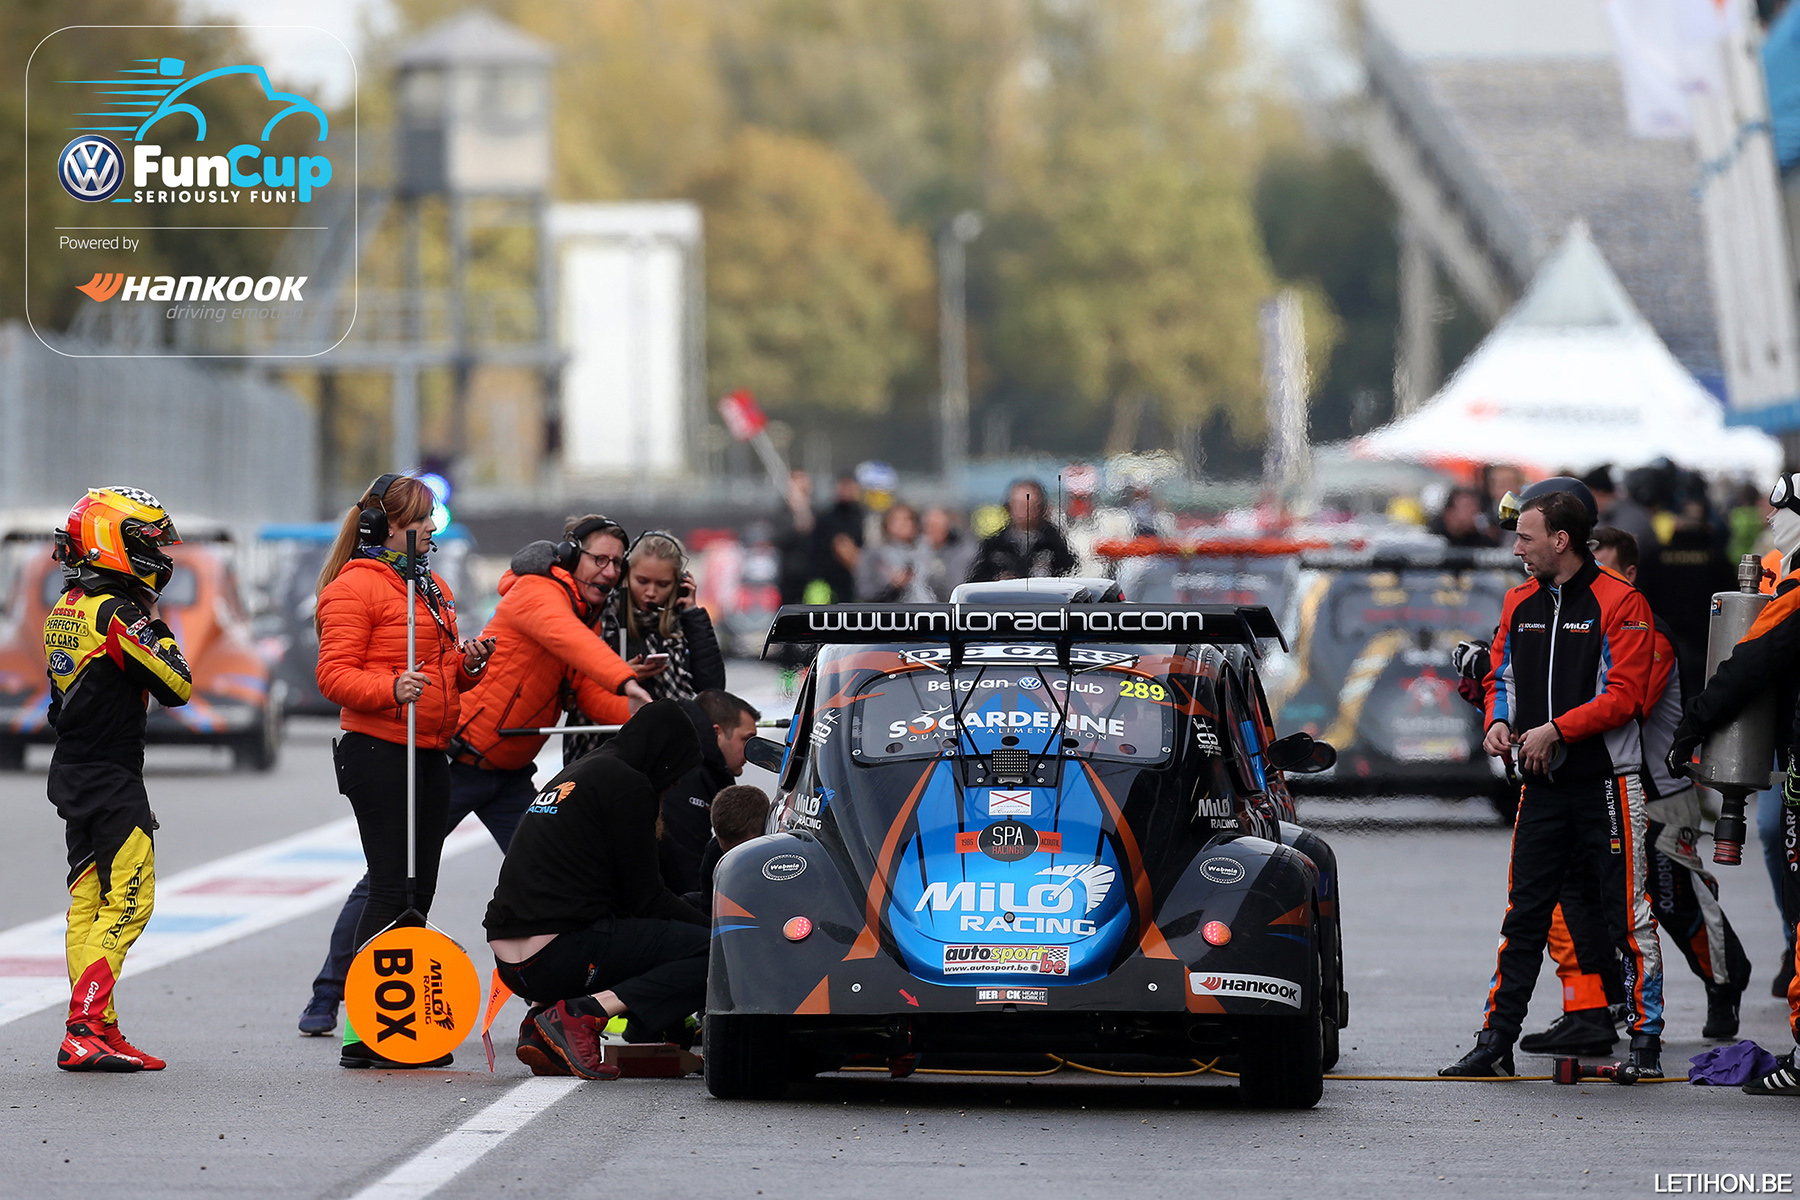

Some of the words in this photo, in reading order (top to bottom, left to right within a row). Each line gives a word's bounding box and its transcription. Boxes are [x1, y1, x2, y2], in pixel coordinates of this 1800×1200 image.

[57, 634, 80, 649] CARS
[1002, 646, 1132, 663] CARS
[927, 678, 1009, 692] Belgian
[1052, 679, 1104, 695] Club
[1119, 680, 1165, 701] 289
[908, 728, 976, 742] QUALITY
[526, 805, 558, 815] ACING
[1210, 818, 1239, 829] RACING
[992, 826, 1024, 846] SPA
[992, 846, 1020, 855] RACING
[960, 915, 1097, 936] RACING
[945, 946, 1049, 963] autosport
[944, 963, 1029, 972] www.autosport.be
[83, 981, 100, 1016] Castrol
[373, 948, 417, 1043] BOX
[423, 975, 432, 1025] RACING
